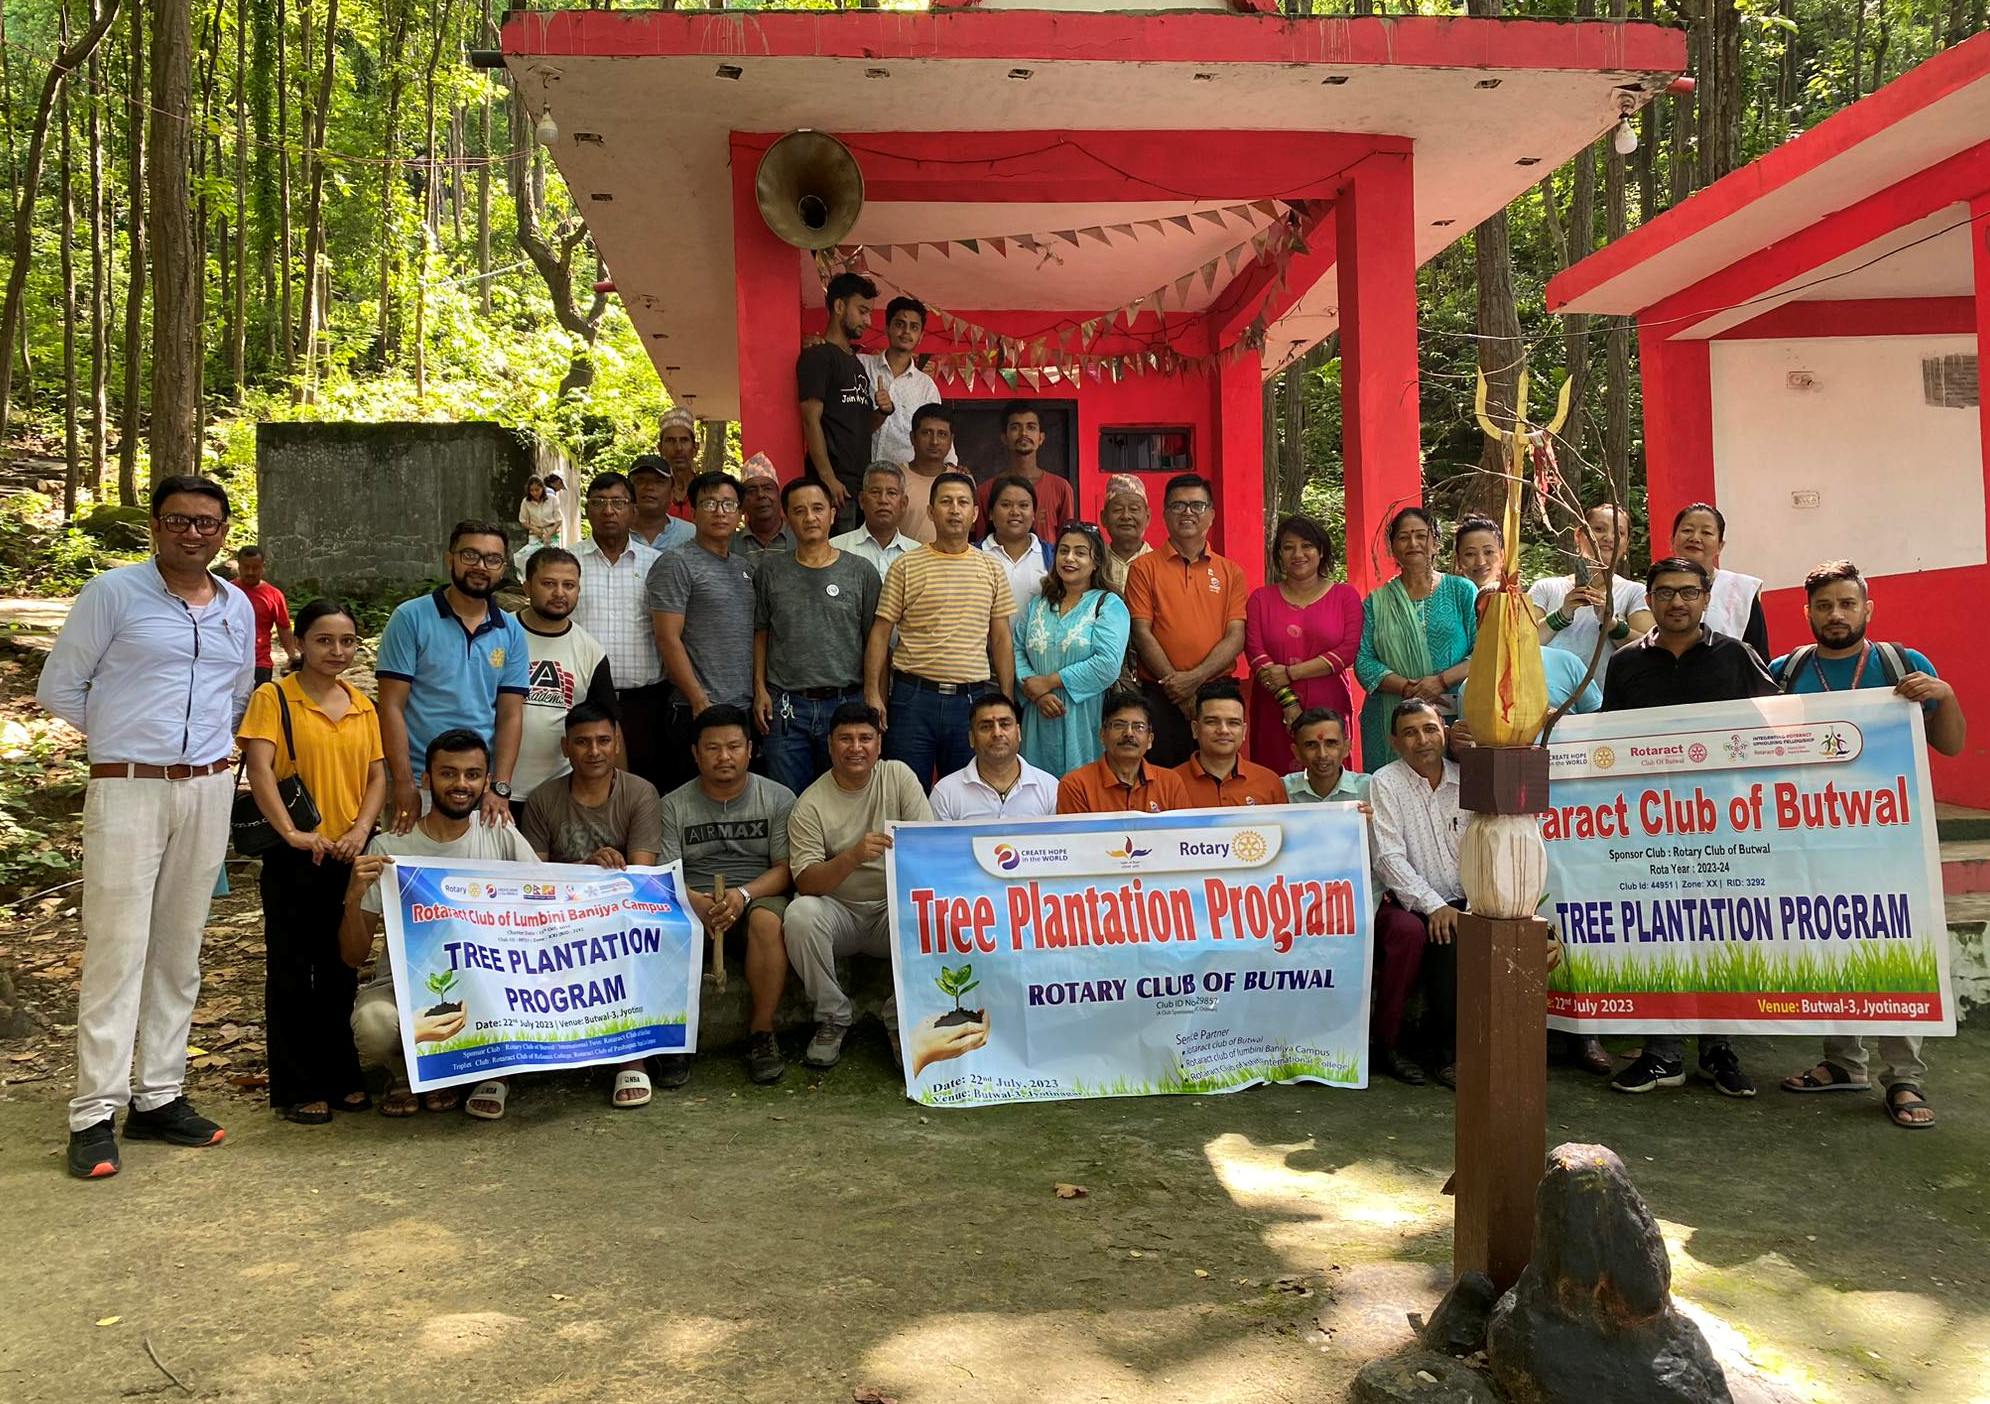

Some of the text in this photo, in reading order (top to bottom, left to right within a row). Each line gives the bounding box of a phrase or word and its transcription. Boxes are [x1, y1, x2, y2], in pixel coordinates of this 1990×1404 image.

[1630, 744, 1684, 757] Rotaract
[1640, 787, 1717, 836] Club
[1729, 784, 1763, 831] of
[1774, 776, 1910, 829] Butwal
[689, 822, 764, 842] AIRMAX
[1180, 842, 1230, 858] Rotary
[1609, 843, 1771, 862] Sponsor Club Rotary Club of Butwal
[1650, 862, 1730, 875] Rota Year 2023-24
[445, 884, 467, 894] Rotary
[1619, 882, 1637, 890] Club
[1650, 881, 1673, 889] 44951
[1682, 880, 1704, 889] Zone:
[1727, 879, 1744, 887] RID:
[1746, 878, 1766, 887] 3292
[413, 899, 671, 927] Rotaract Club of Lumbini Banijya Campus
[911, 875, 1355, 954] Tree Plantation Program
[1556, 894, 1912, 944] TREE PLANTATION PROGRAM
[444, 927, 661, 975] TREE PLANTATION
[504, 974, 627, 1014] PROGRAM
[1029, 969, 1335, 1006] ROTARY CLUB OF BUTWAL
[1156, 1000, 1174, 1009] Club
[1573, 998, 1598, 1016] July
[1601, 999, 1634, 1012] 2023
[1757, 999, 1930, 1017] Venue: Butwal-3, Jyotinagar
[476, 1020, 501, 1030] Date:
[520, 1020, 534, 1030] July
[535, 1020, 554, 1029] 2023
[560, 1018, 584, 1028] Venue:
[584, 1010, 619, 1024] Butwal-3,
[1200, 1028, 1229, 1040] Partner
[1212, 1040, 1227, 1050] club
[1229, 1038, 1237, 1046] of
[1238, 1036, 1264, 1045] Butwal
[1186, 1056, 1213, 1067] Rotaract
[1213, 1052, 1228, 1062] club
[1229, 1049, 1237, 1059] of
[1295, 1045, 1330, 1057] Campus
[1190, 1067, 1220, 1081] Rotaract
[1220, 1064, 1236, 1072] Club
[933, 1074, 1059, 1093] Date: 22nd July, 2023
[933, 1090, 971, 1103] Venue:
